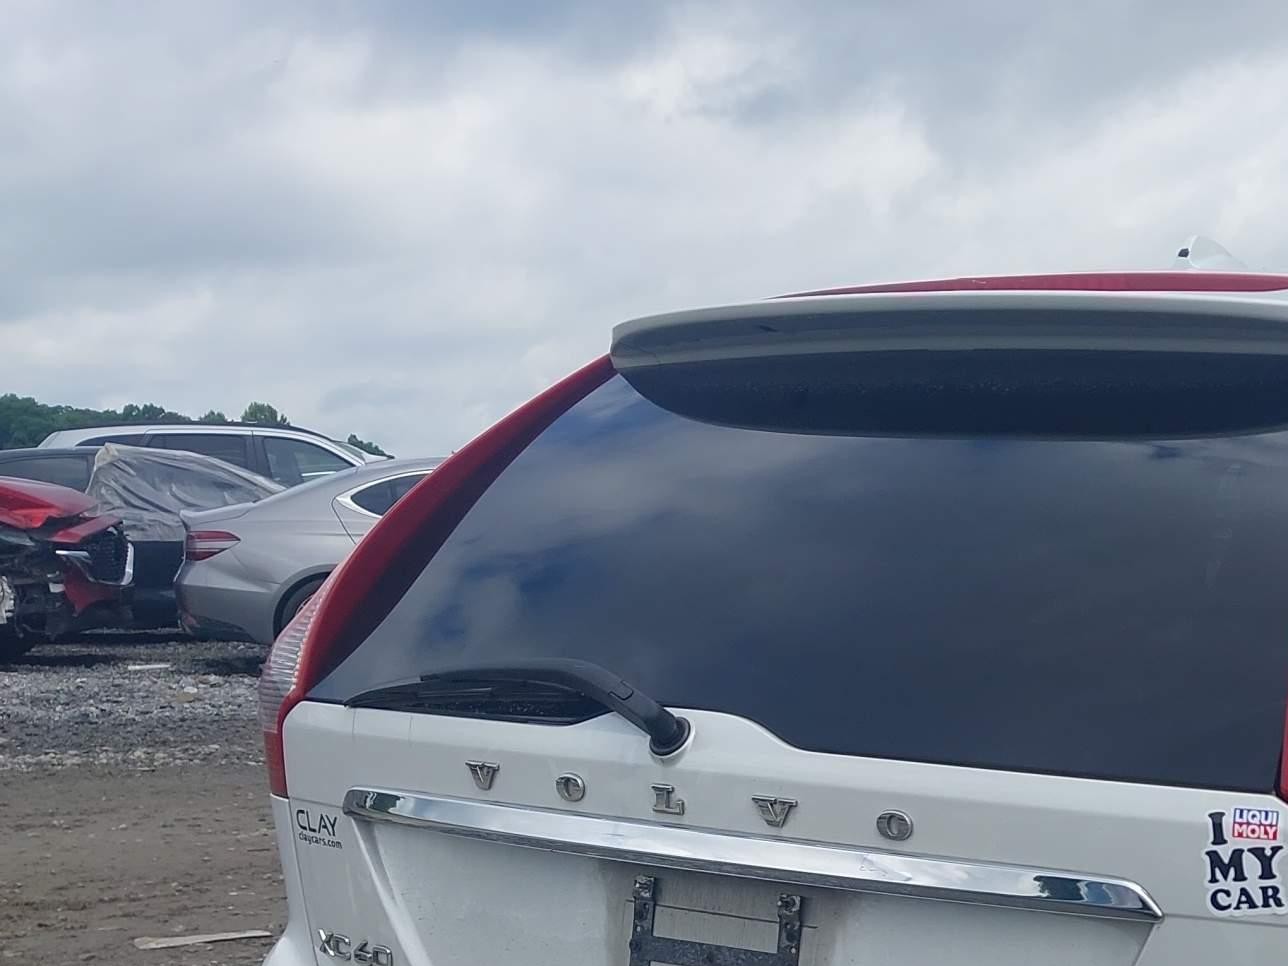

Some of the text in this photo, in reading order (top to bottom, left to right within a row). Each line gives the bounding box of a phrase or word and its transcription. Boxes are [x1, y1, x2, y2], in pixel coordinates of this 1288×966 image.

[464, 759, 914, 842] VOLVO
[296, 809, 338, 837] CLAY
[1208, 812, 1228, 845] I
[1234, 808, 1278, 826] LIQUI
[299, 831, 343, 850] claycars.com
[1233, 823, 1277, 840] MOLY
[1205, 845, 1284, 883] MY
[1210, 885, 1285, 911] CAR
